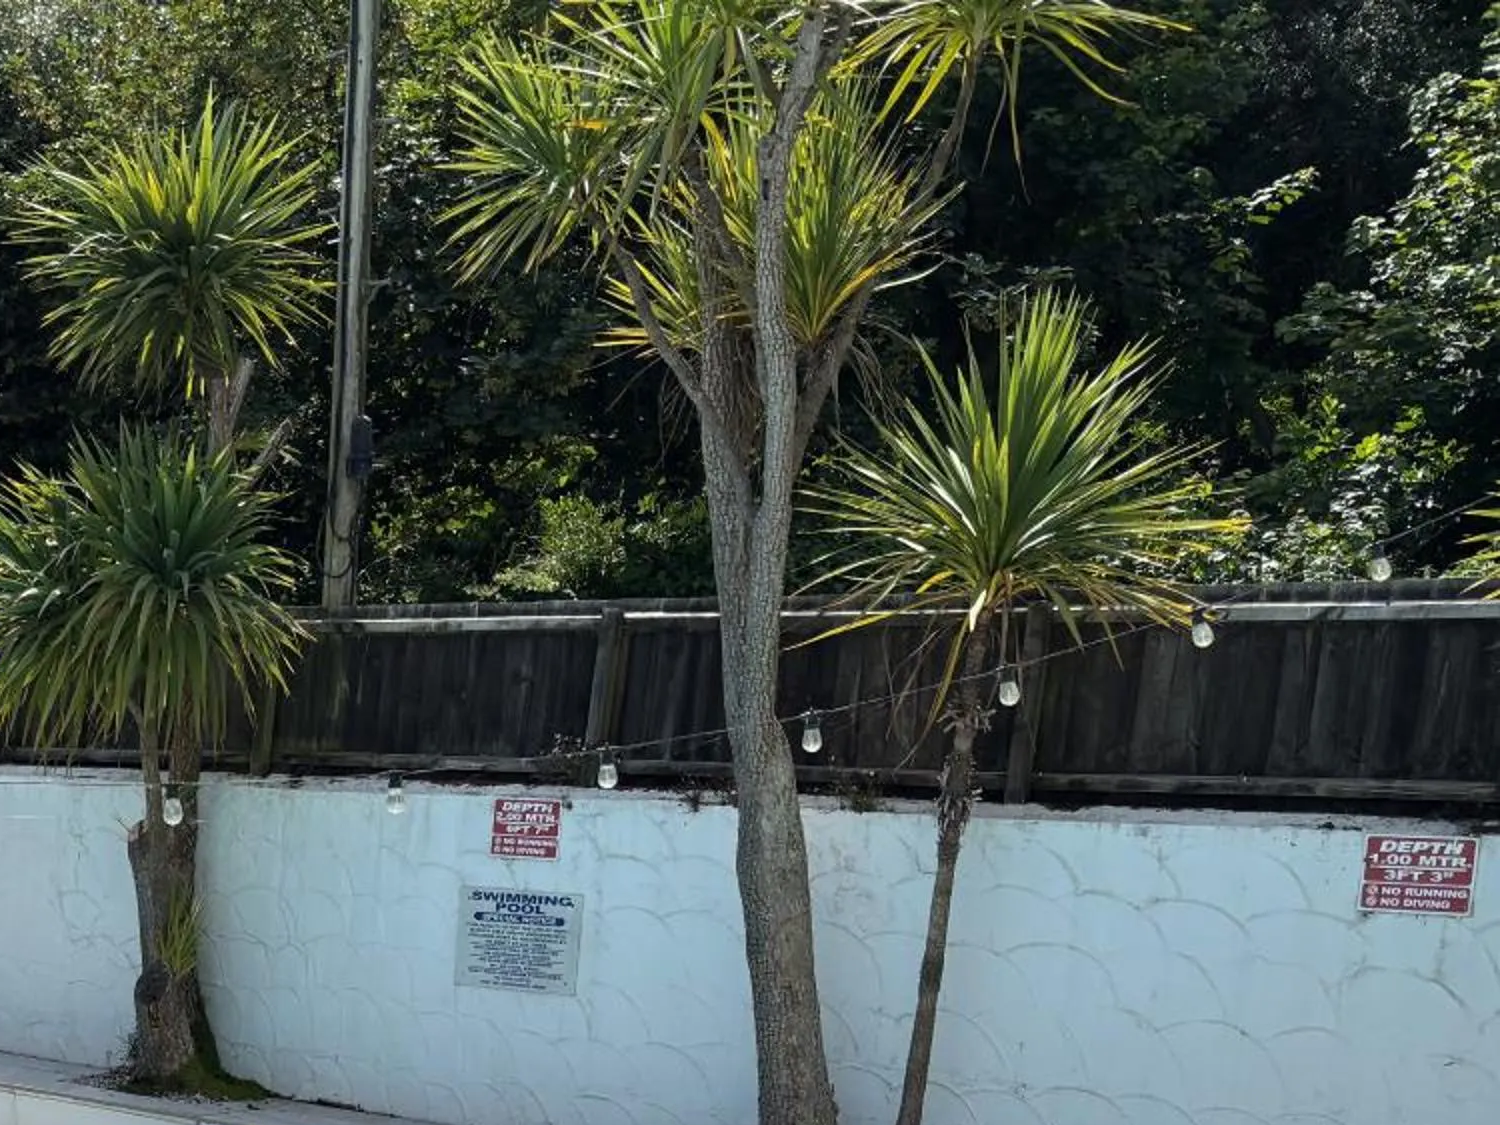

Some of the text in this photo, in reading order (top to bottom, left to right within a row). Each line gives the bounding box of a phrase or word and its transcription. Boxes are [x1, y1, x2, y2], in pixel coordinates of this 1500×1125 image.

[502, 802, 553, 812] DEPTH
[1380, 841, 1464, 855] DEPTH
[1369, 853, 1412, 865] 1.00
[1384, 869, 1422, 881] 3FT
[1381, 886, 1468, 899] NO RUNNING
[471, 890, 574, 908] SWIMMING
[1380, 897, 1451, 909] NO DIVING
[496, 902, 544, 914] POOL
